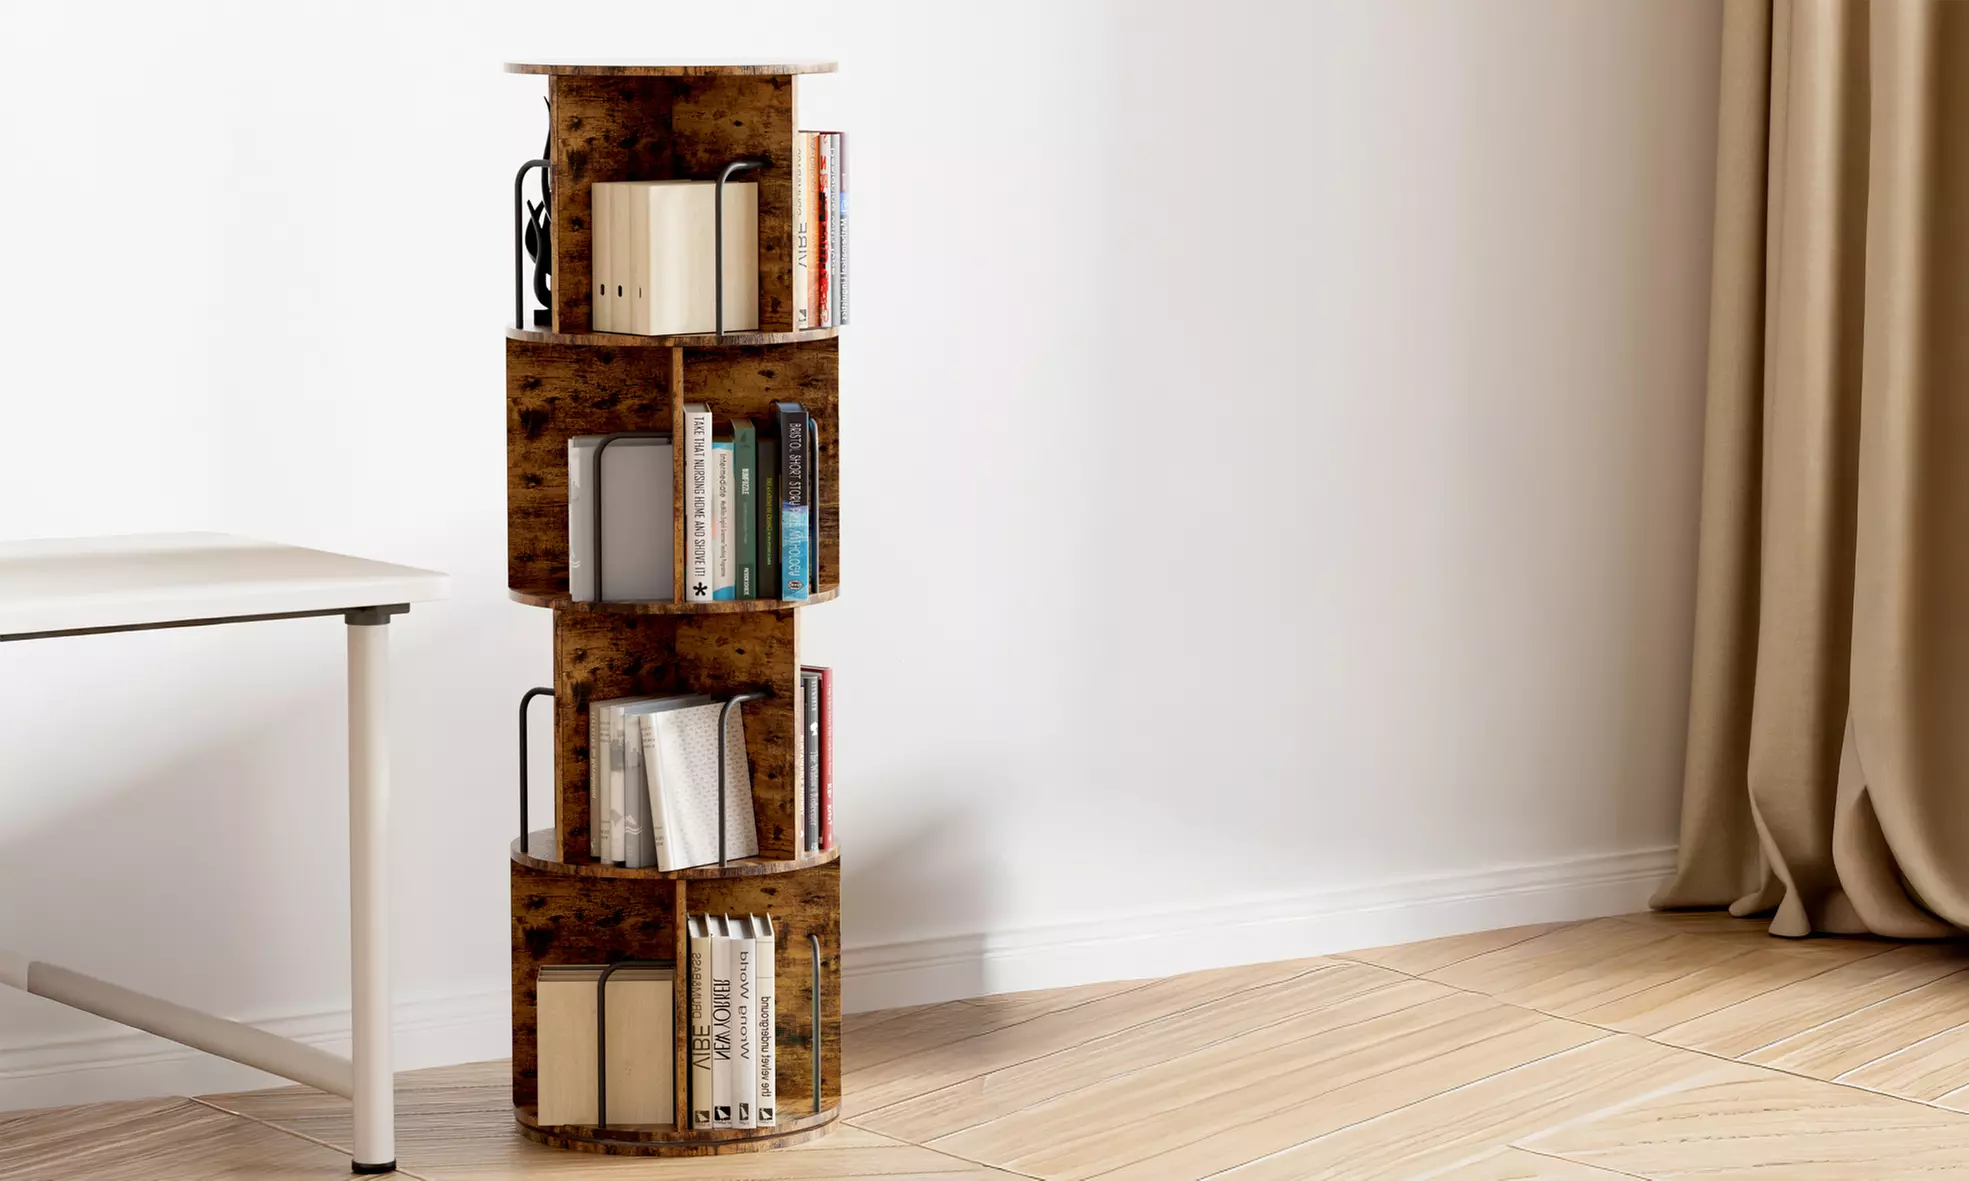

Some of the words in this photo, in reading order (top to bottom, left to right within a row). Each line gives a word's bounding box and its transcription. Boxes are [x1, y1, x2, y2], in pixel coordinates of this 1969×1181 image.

[694, 416, 705, 435] TAKE
[694, 438, 705, 457] THAT
[694, 459, 705, 495] NURSING
[789, 454, 802, 480] SHORT
[694, 497, 705, 519] HOME
[694, 521, 705, 537] AND
[694, 539, 705, 565] SHOVE
